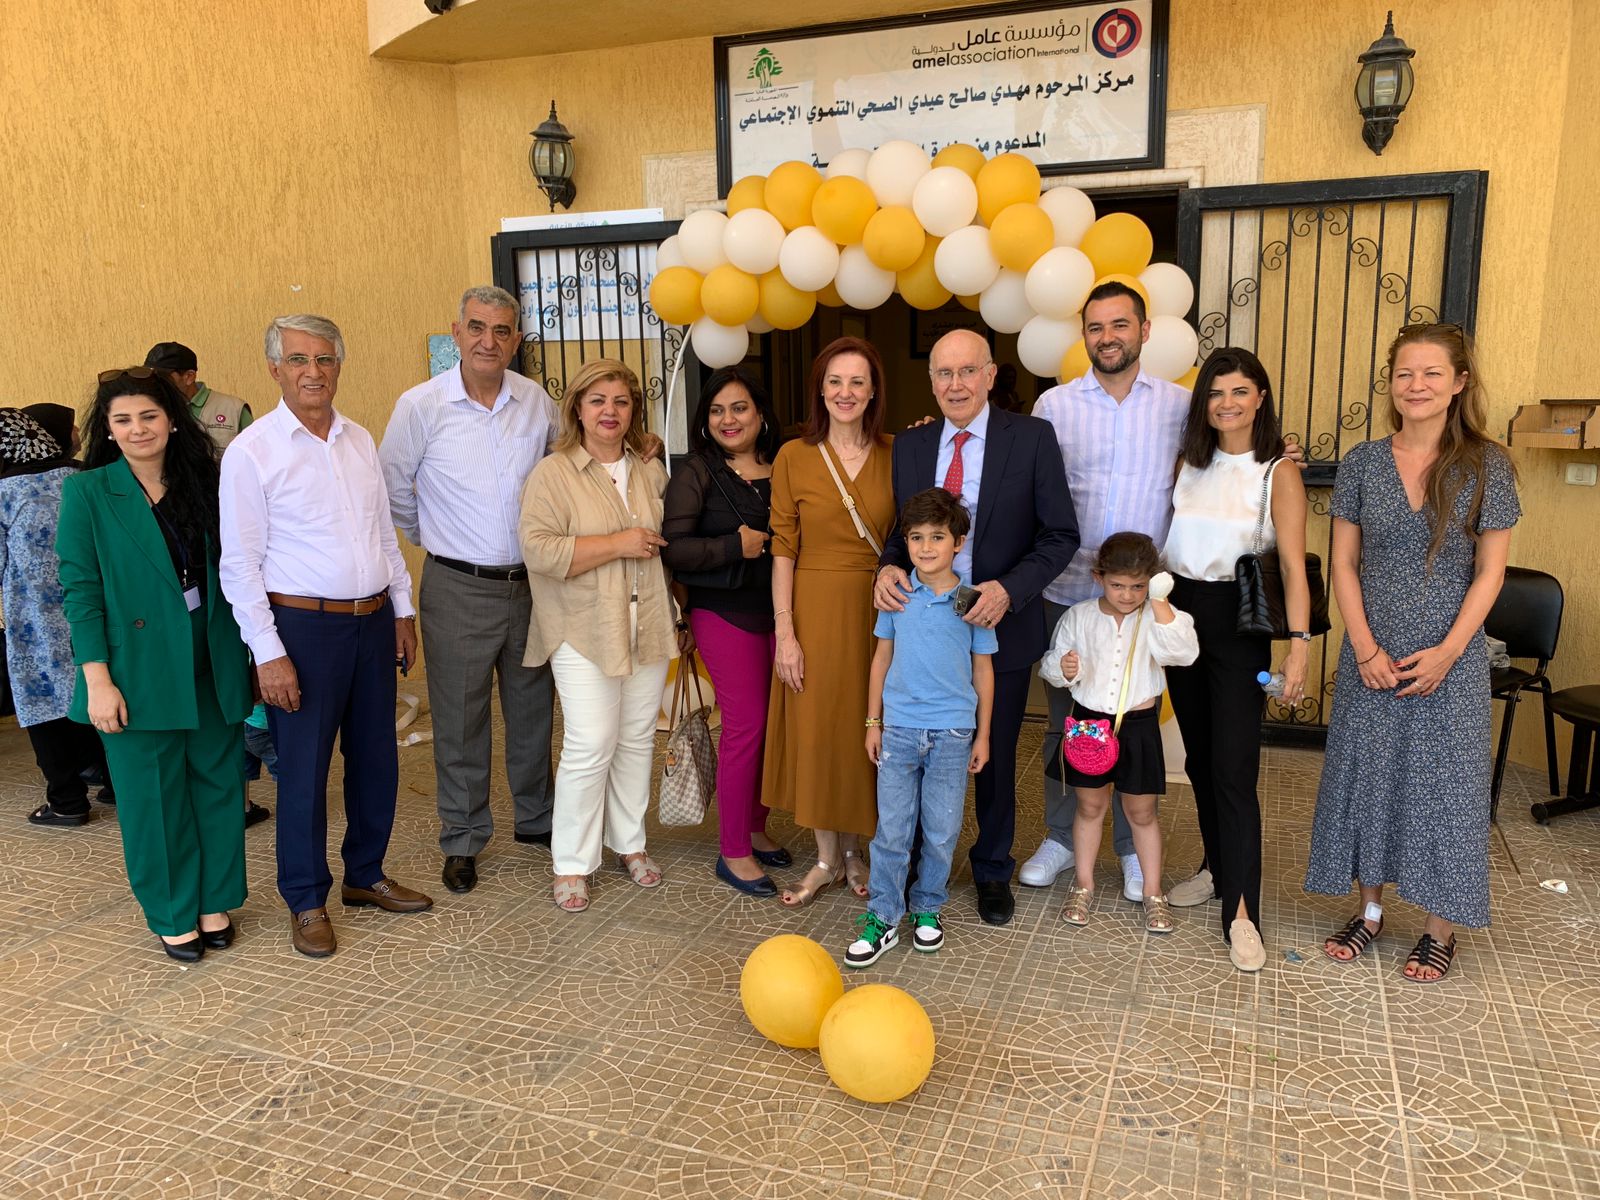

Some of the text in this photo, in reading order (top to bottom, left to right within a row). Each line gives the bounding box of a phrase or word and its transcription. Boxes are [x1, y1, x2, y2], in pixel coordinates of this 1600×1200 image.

[957, 28, 1002, 51] عامل
[1004, 18, 1081, 42] مؤسسة
[739, 70, 1134, 132] مركز المرحوم مهدي صالح عيدي الصحي التنموي الإجتماعي
[994, 131, 1046, 154] المدعوم
